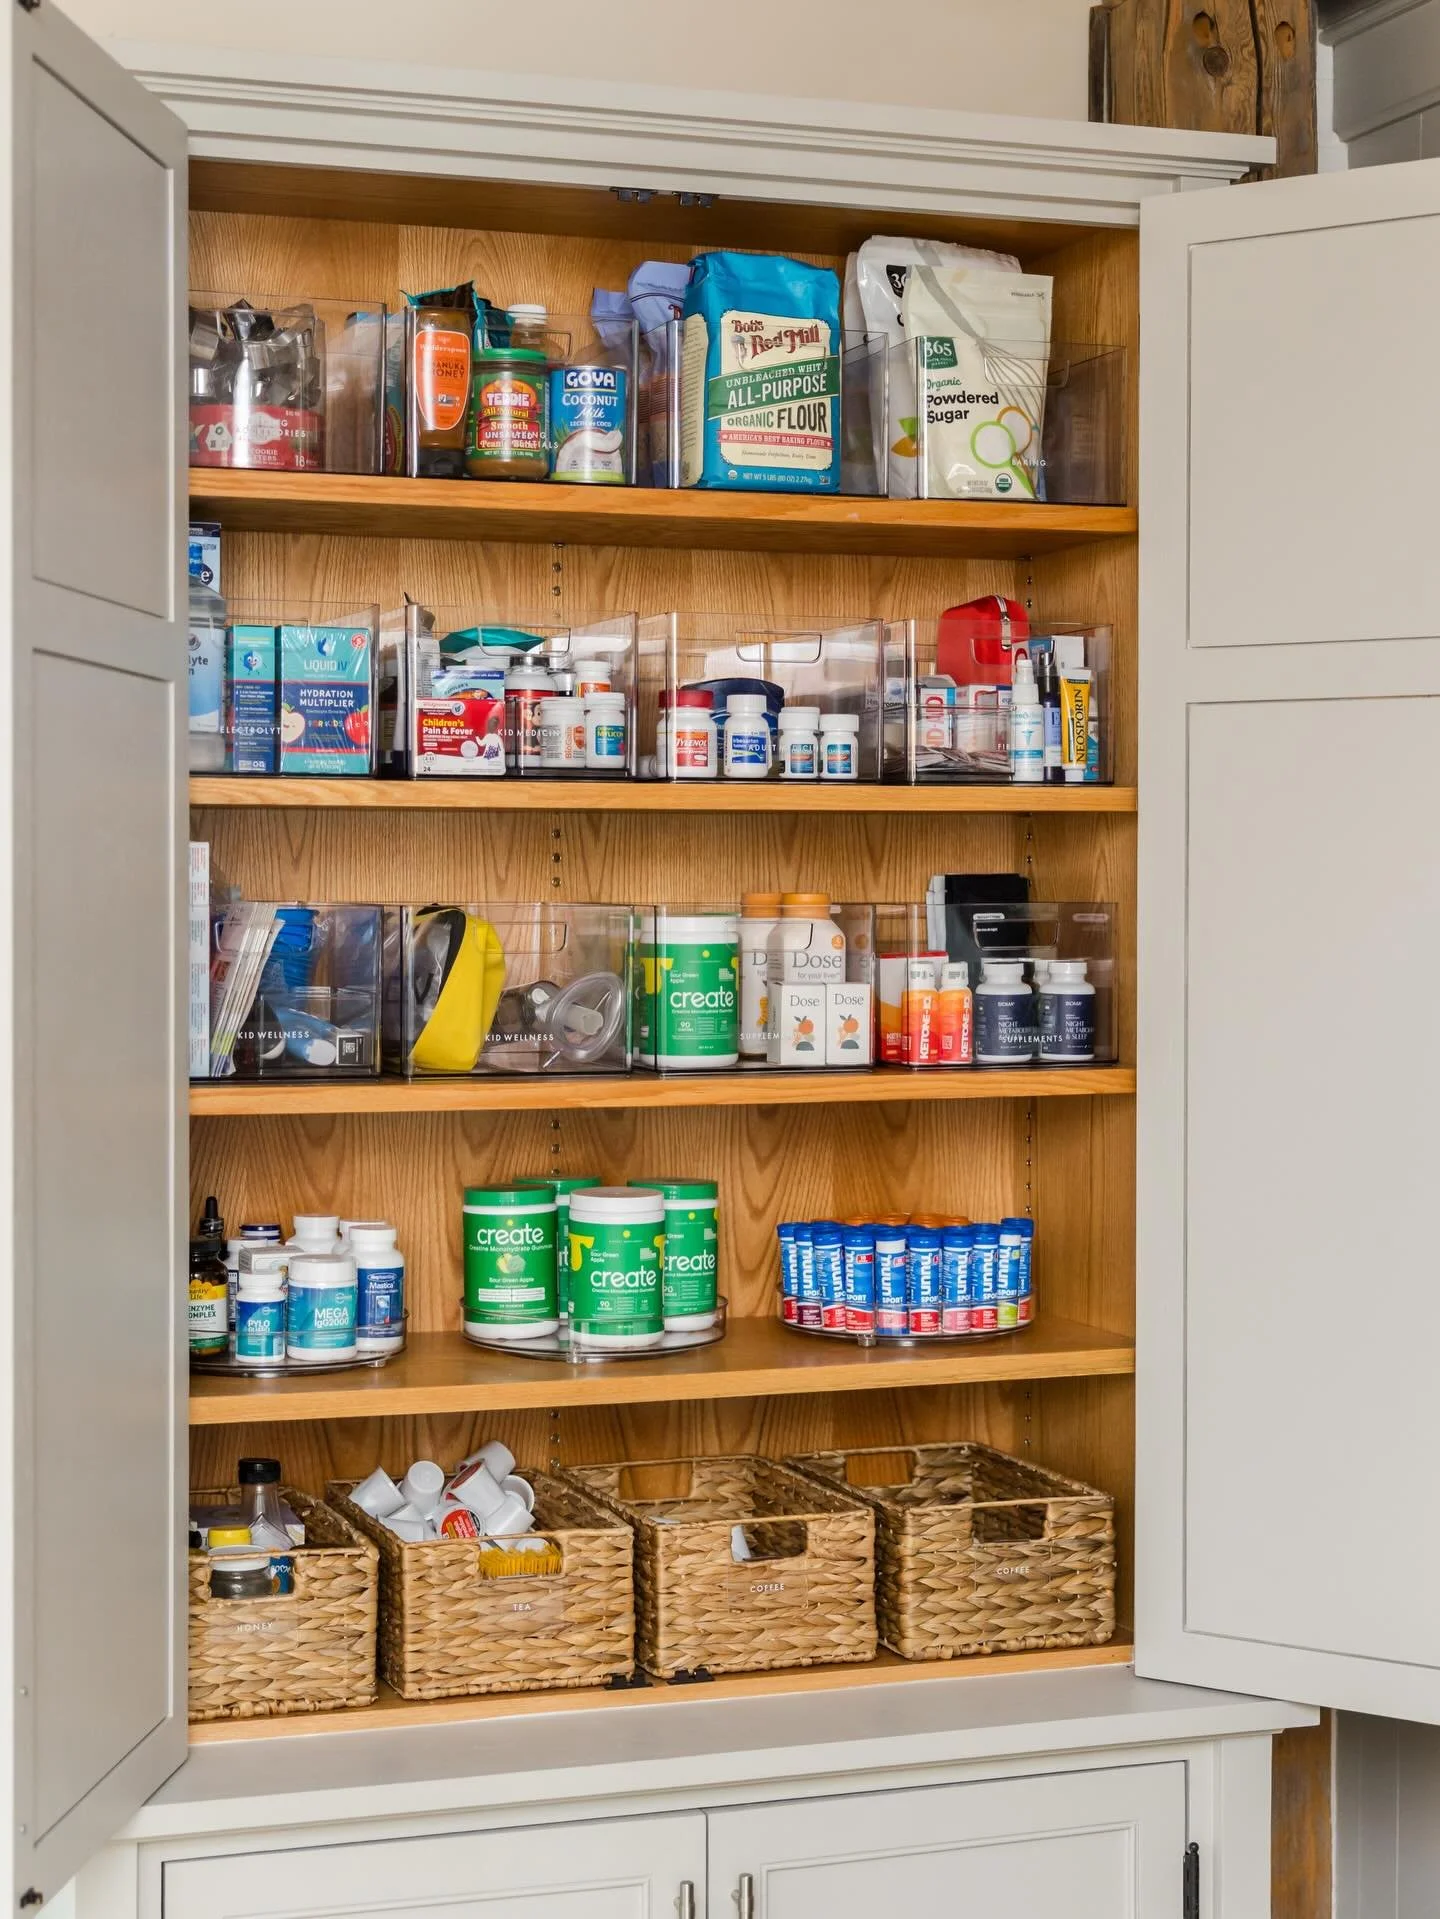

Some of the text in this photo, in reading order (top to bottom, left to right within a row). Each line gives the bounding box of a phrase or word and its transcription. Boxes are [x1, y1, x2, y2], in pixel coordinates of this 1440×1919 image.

[731, 319, 764, 333] Bob's
[749, 324, 821, 361] Red Mill
[566, 371, 616, 388] GOYA
[725, 367, 796, 389] UNBLEACHED
[926, 376, 962, 392] Organic
[727, 373, 828, 410] ALL-PURPOSE
[486, 392, 531, 407] TEDDIE
[561, 393, 619, 407] COCONUT
[926, 390, 999, 408] Powdered
[484, 407, 496, 417] All
[574, 405, 606, 419] Milk
[726, 401, 828, 434] ORGANIC FLOUR
[926, 409, 970, 424] Sugar
[490, 421, 529, 431] Smooth
[763, 435, 780, 443] BEST
[781, 436, 807, 445] BAKING
[294, 454, 306, 468] 18
[303, 659, 337, 672] LIQUID
[300, 688, 354, 699] HYDRATION
[299, 698, 355, 708] MULTIPLIER
[422, 718, 464, 727] Children's
[1073, 688, 1086, 763] NEOSPORIN
[422, 727, 474, 736] Pain & Fever
[497, 728, 561, 738] KID MEDICIN
[791, 950, 843, 969] Dose
[669, 985, 734, 1009] create
[789, 994, 821, 1008] Dose
[833, 992, 865, 1007] Dose
[680, 1020, 691, 1029] 90
[237, 1030, 311, 1040] KID WELLNESS
[484, 1033, 555, 1042] KID WELLNESS
[1001, 1034, 1063, 1044] SUPPLEMENTS
[477, 1222, 545, 1245] create
[590, 1265, 657, 1288] create
[599, 1300, 611, 1308] 90
[846, 1294, 868, 1302] SPORT
[188, 1311, 217, 1319] OMPLEX
[314, 1307, 349, 1320] MEGA
[247, 1319, 271, 1328] PYLO
[996, 1565, 1031, 1576] COFFEE
[749, 1583, 786, 1594] COFFEE
[512, 1602, 532, 1612] TEA
[236, 1621, 273, 1633] HONEY
